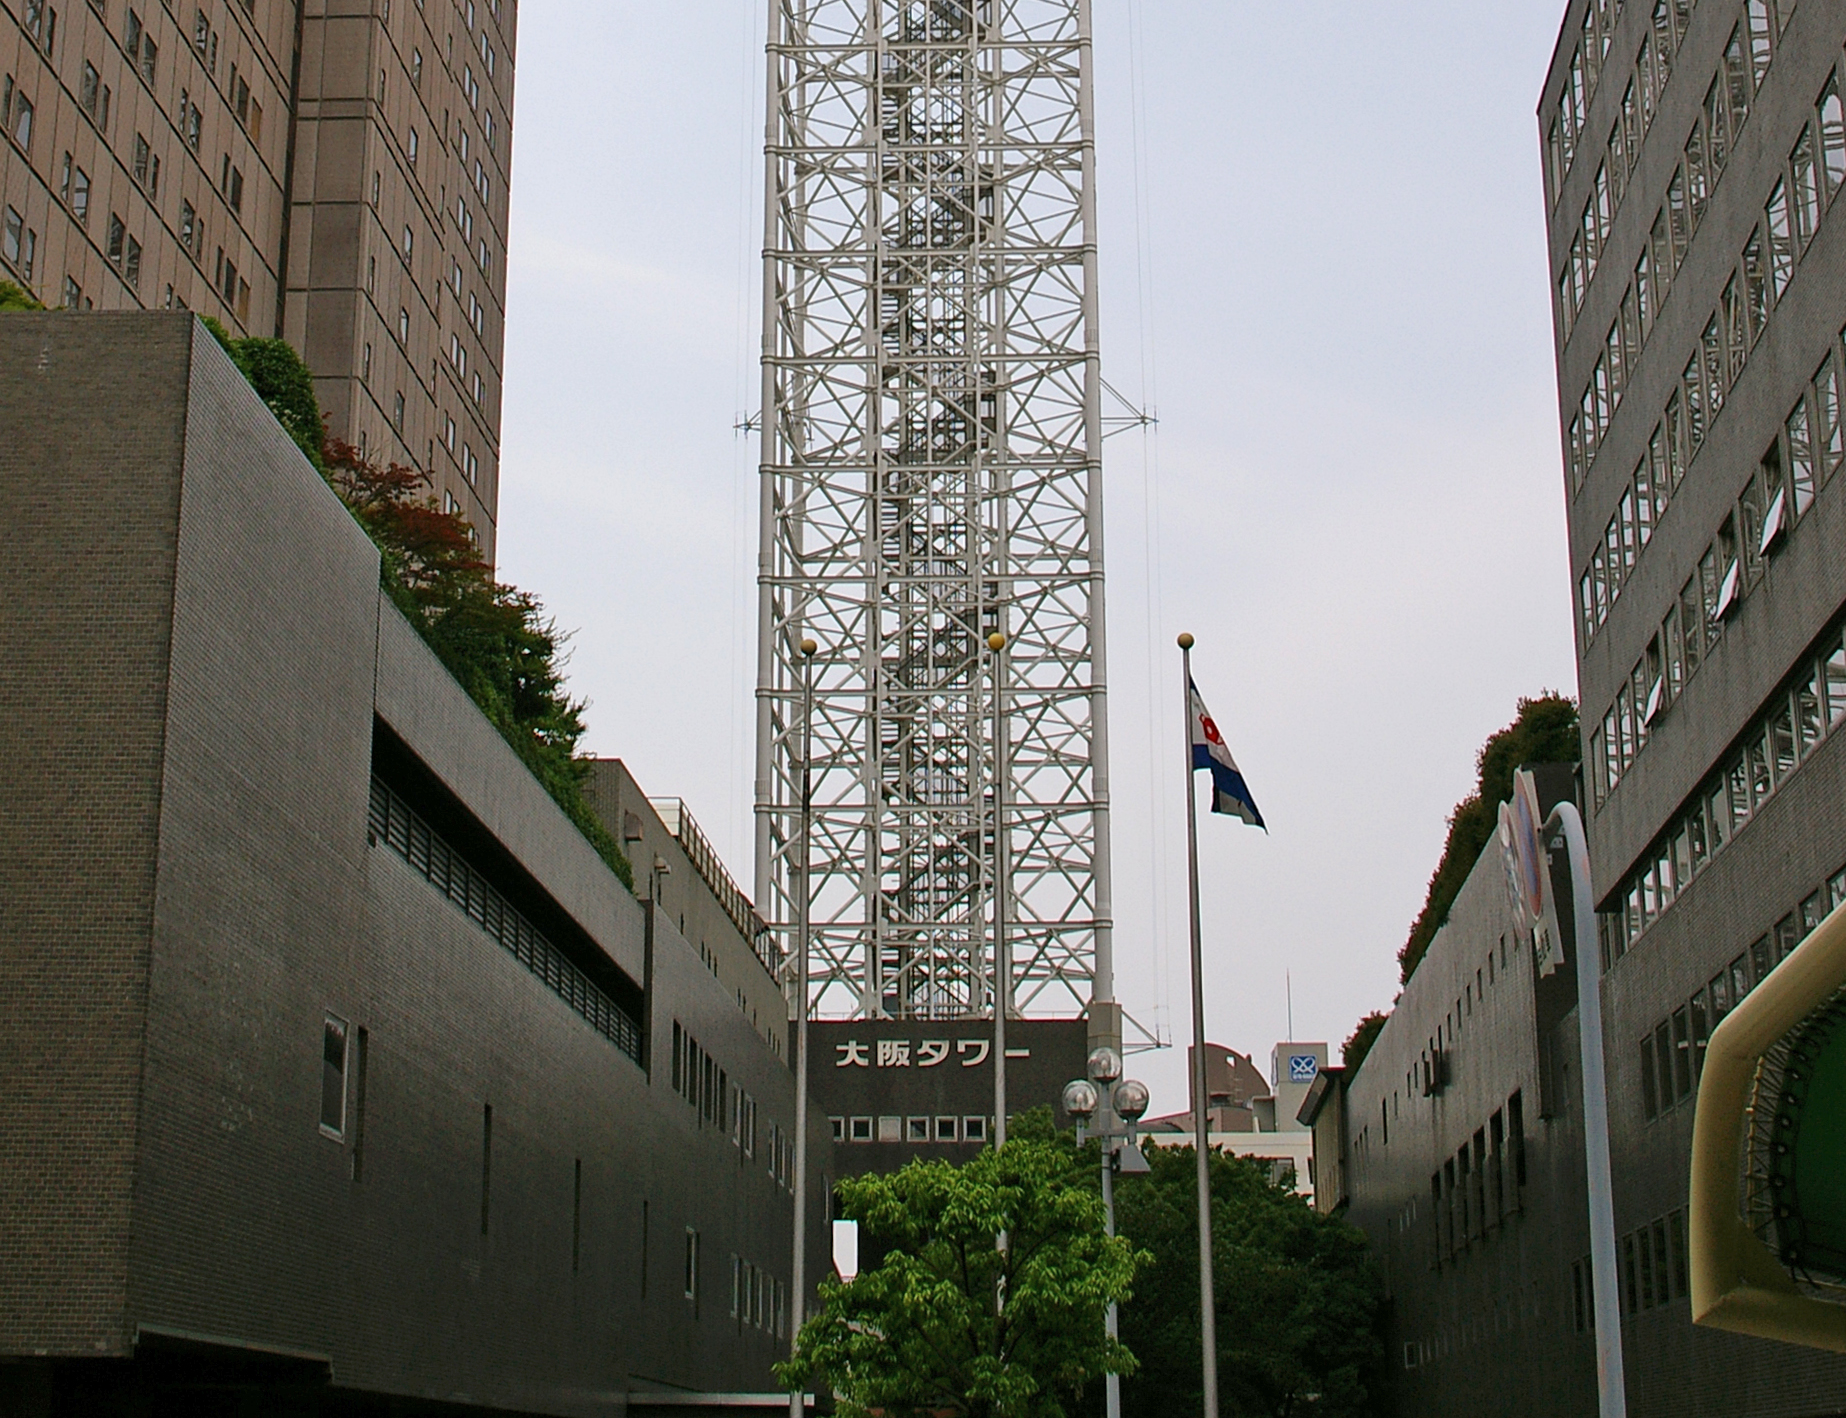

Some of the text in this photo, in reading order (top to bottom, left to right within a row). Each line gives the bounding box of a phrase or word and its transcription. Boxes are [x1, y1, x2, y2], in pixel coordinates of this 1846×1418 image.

[836, 1039, 1030, 1067] 大阪タワー
